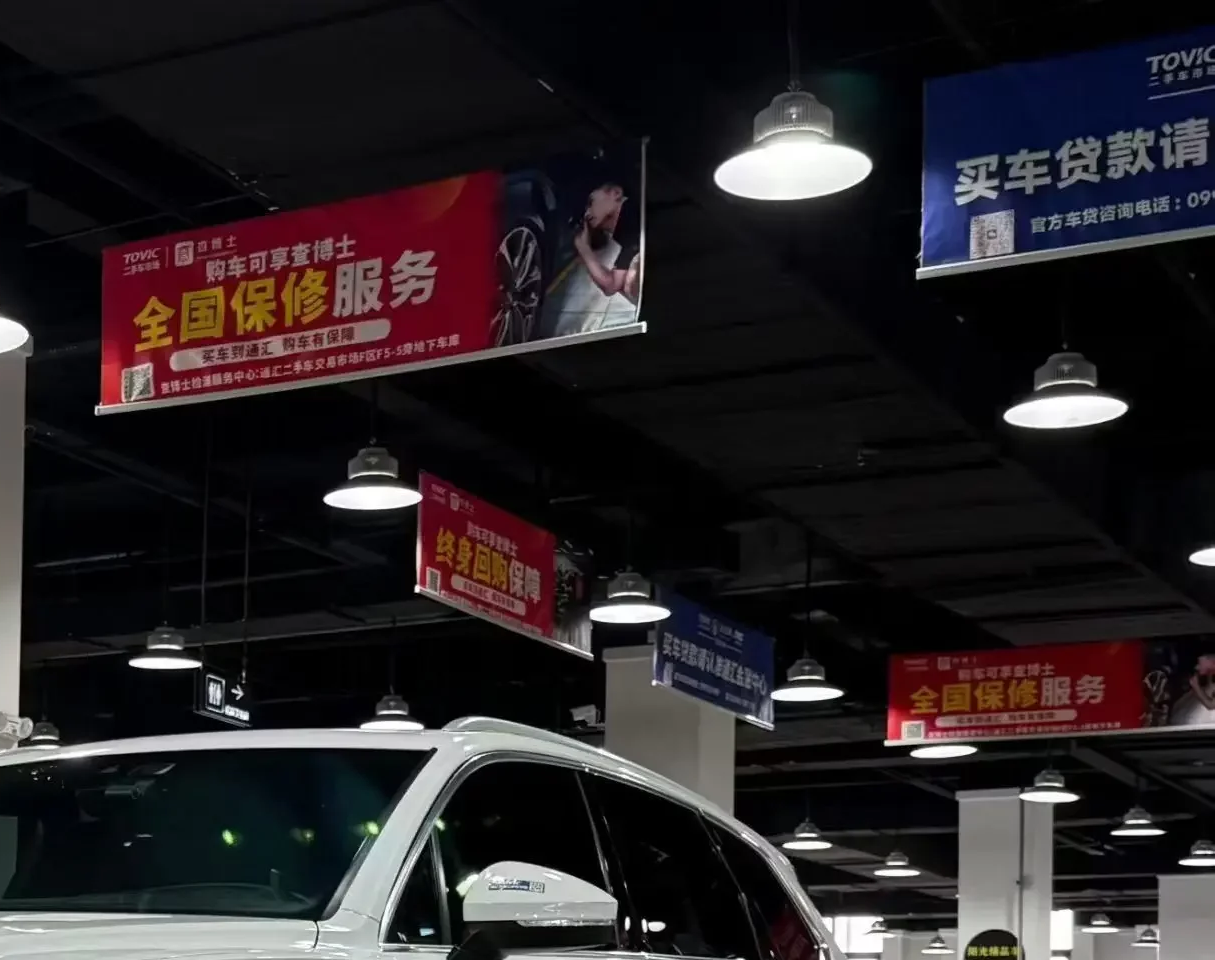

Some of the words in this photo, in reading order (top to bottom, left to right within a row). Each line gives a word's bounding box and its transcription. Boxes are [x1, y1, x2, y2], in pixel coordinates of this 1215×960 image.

[1146, 45, 1215, 74] TOVIC
[954, 117, 1210, 206] 买车贷款请
[1030, 190, 1215, 234] 官方车贷咨询电话：09
[123, 247, 161, 265] TOVIC
[205, 234, 357, 283] 购车可享查博士
[133, 249, 438, 353] 全国保修服务
[201, 339, 274, 364] 买车到通汇
[282, 326, 355, 351] 购车有保障
[435, 525, 542, 605] 终身回购保障
[910, 674, 1106, 714] 全国保修服务
